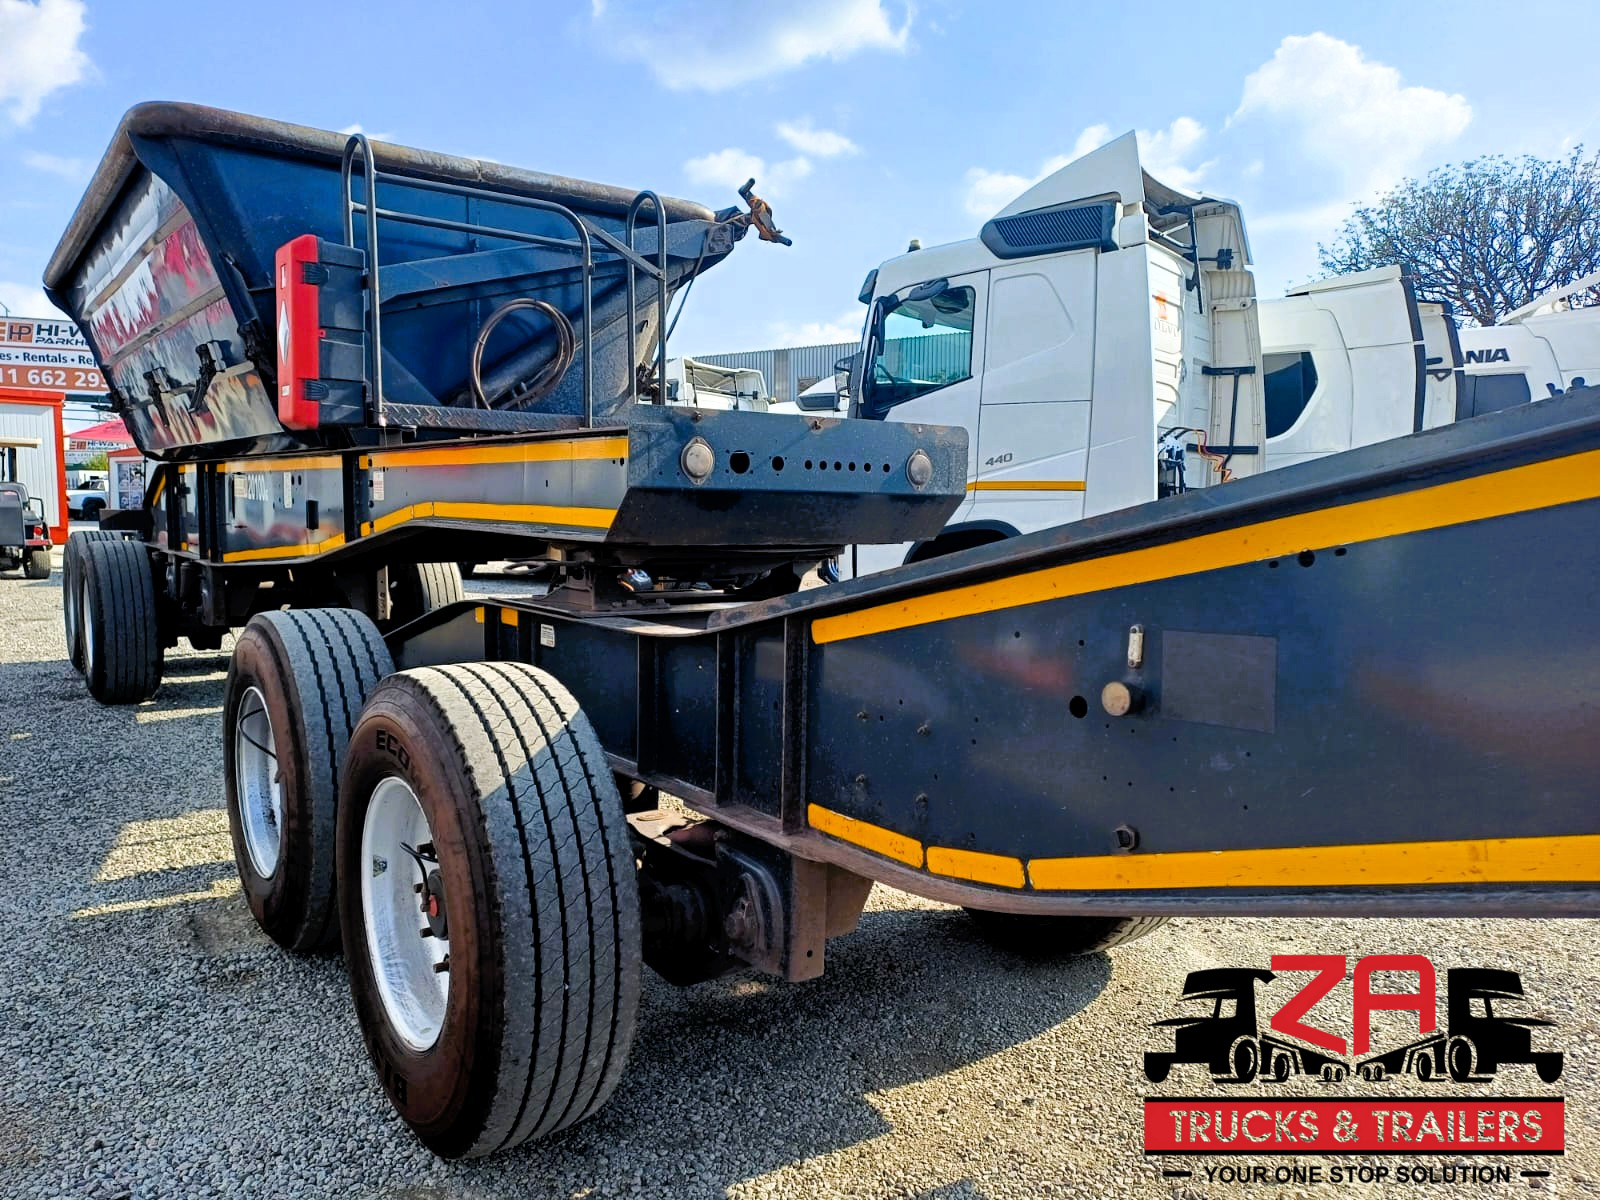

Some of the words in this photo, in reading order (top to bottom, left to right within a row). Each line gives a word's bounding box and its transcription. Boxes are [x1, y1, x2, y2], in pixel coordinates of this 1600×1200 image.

[35, 336, 87, 347] PARKH
[0, 351, 12, 361] es
[22, 351, 68, 363] Rentals
[1463, 347, 1511, 364] NIA
[0, 367, 18, 384] 11
[27, 369, 67, 386] 662
[985, 452, 1013, 466] 440
